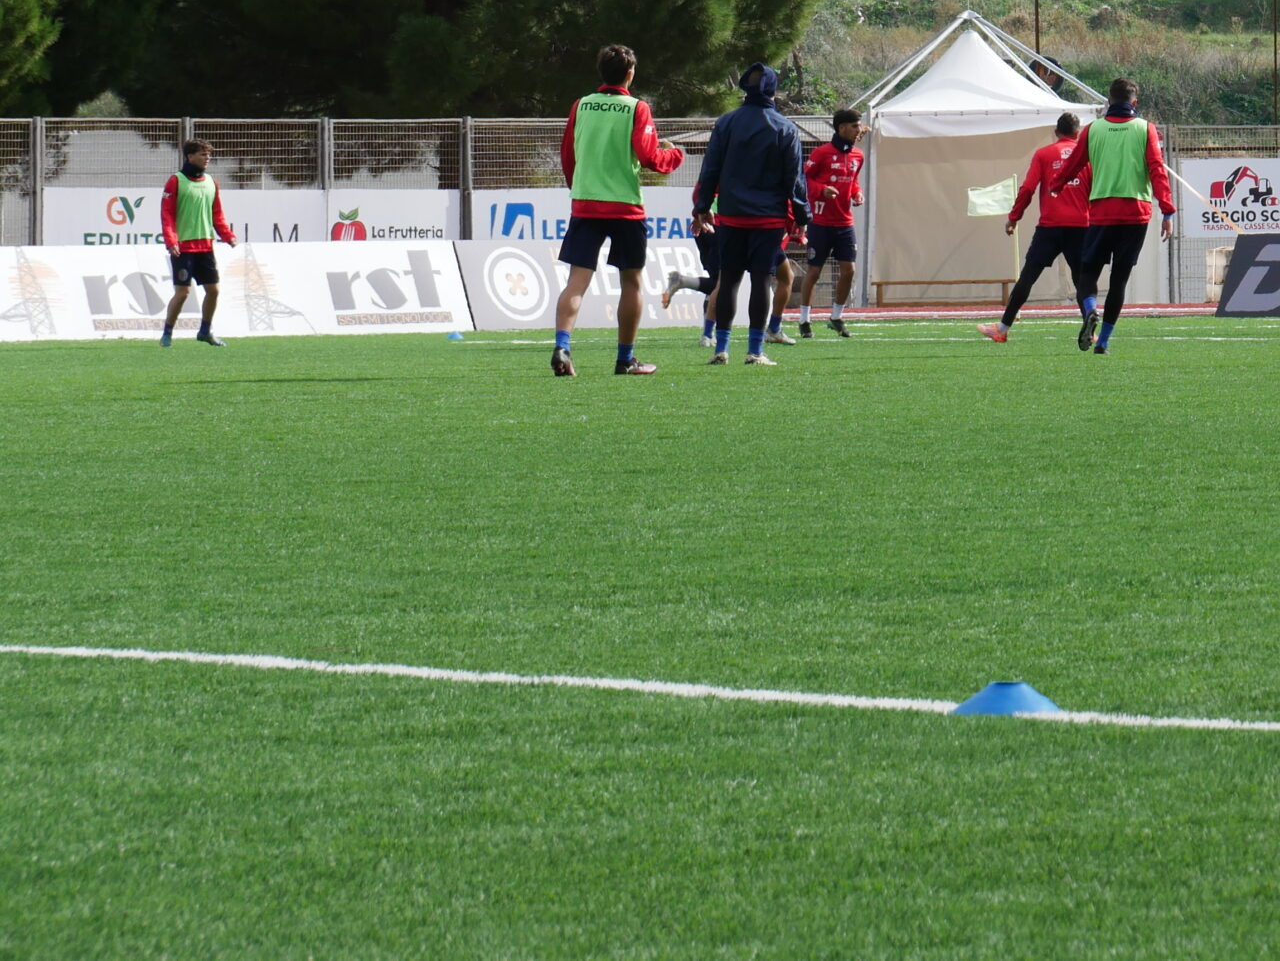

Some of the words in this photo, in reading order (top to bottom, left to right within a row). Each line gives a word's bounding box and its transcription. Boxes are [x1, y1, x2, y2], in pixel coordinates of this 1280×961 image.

[580, 101, 631, 114] macron
[814, 200, 826, 215] 17
[371, 226, 386, 239] La
[388, 225, 444, 239] Frutteria
[326, 250, 442, 311] rst
